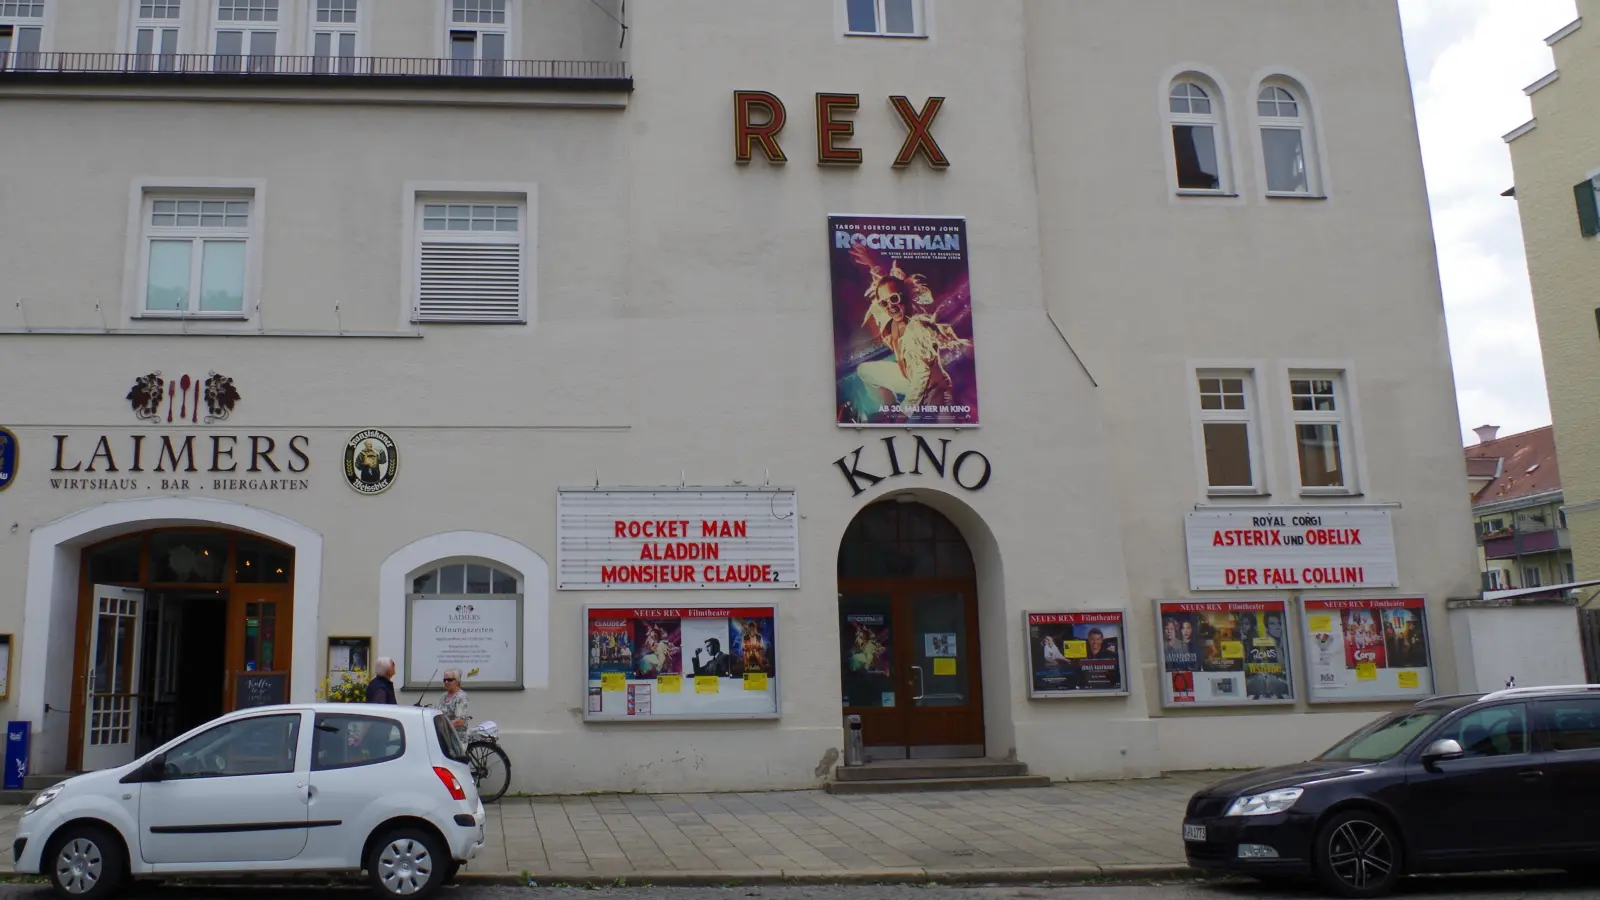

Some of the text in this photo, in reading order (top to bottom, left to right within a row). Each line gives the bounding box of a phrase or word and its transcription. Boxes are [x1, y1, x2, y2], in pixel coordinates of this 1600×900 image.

[734, 89, 950, 168] REX
[835, 230, 960, 251] ROCKETMAN
[878, 405, 890, 413] AB
[921, 405, 938, 413] HIER
[939, 405, 949, 413] IM
[950, 405, 971, 413] KINO
[50, 434, 310, 473] LAIMERS
[832, 435, 992, 498] KINO
[50, 478, 310, 490] WIRTSHAUS BAR BIERGARTEN
[614, 520, 747, 538] ROCKET MAN
[1252, 516, 1322, 527] ROYAL CORGI
[1212, 528, 1362, 546] ASTERIX UND OBELIX
[639, 542, 719, 560] ALADDIN
[601, 565, 696, 583] MONSIEUR
[703, 564, 771, 583] CLAUDE
[1225, 566, 1365, 585] DER FALL COLLINI
[633, 609, 731, 617] NEUES REX Filmtheater
[1180, 603, 1205, 611] NEUES
[1206, 603, 1222, 611] REX
[1030, 613, 1120, 622] NEUES REX Filmtheater
[435, 626, 494, 634] Öffnungszeiten
[1354, 650, 1376, 661] Corgi
